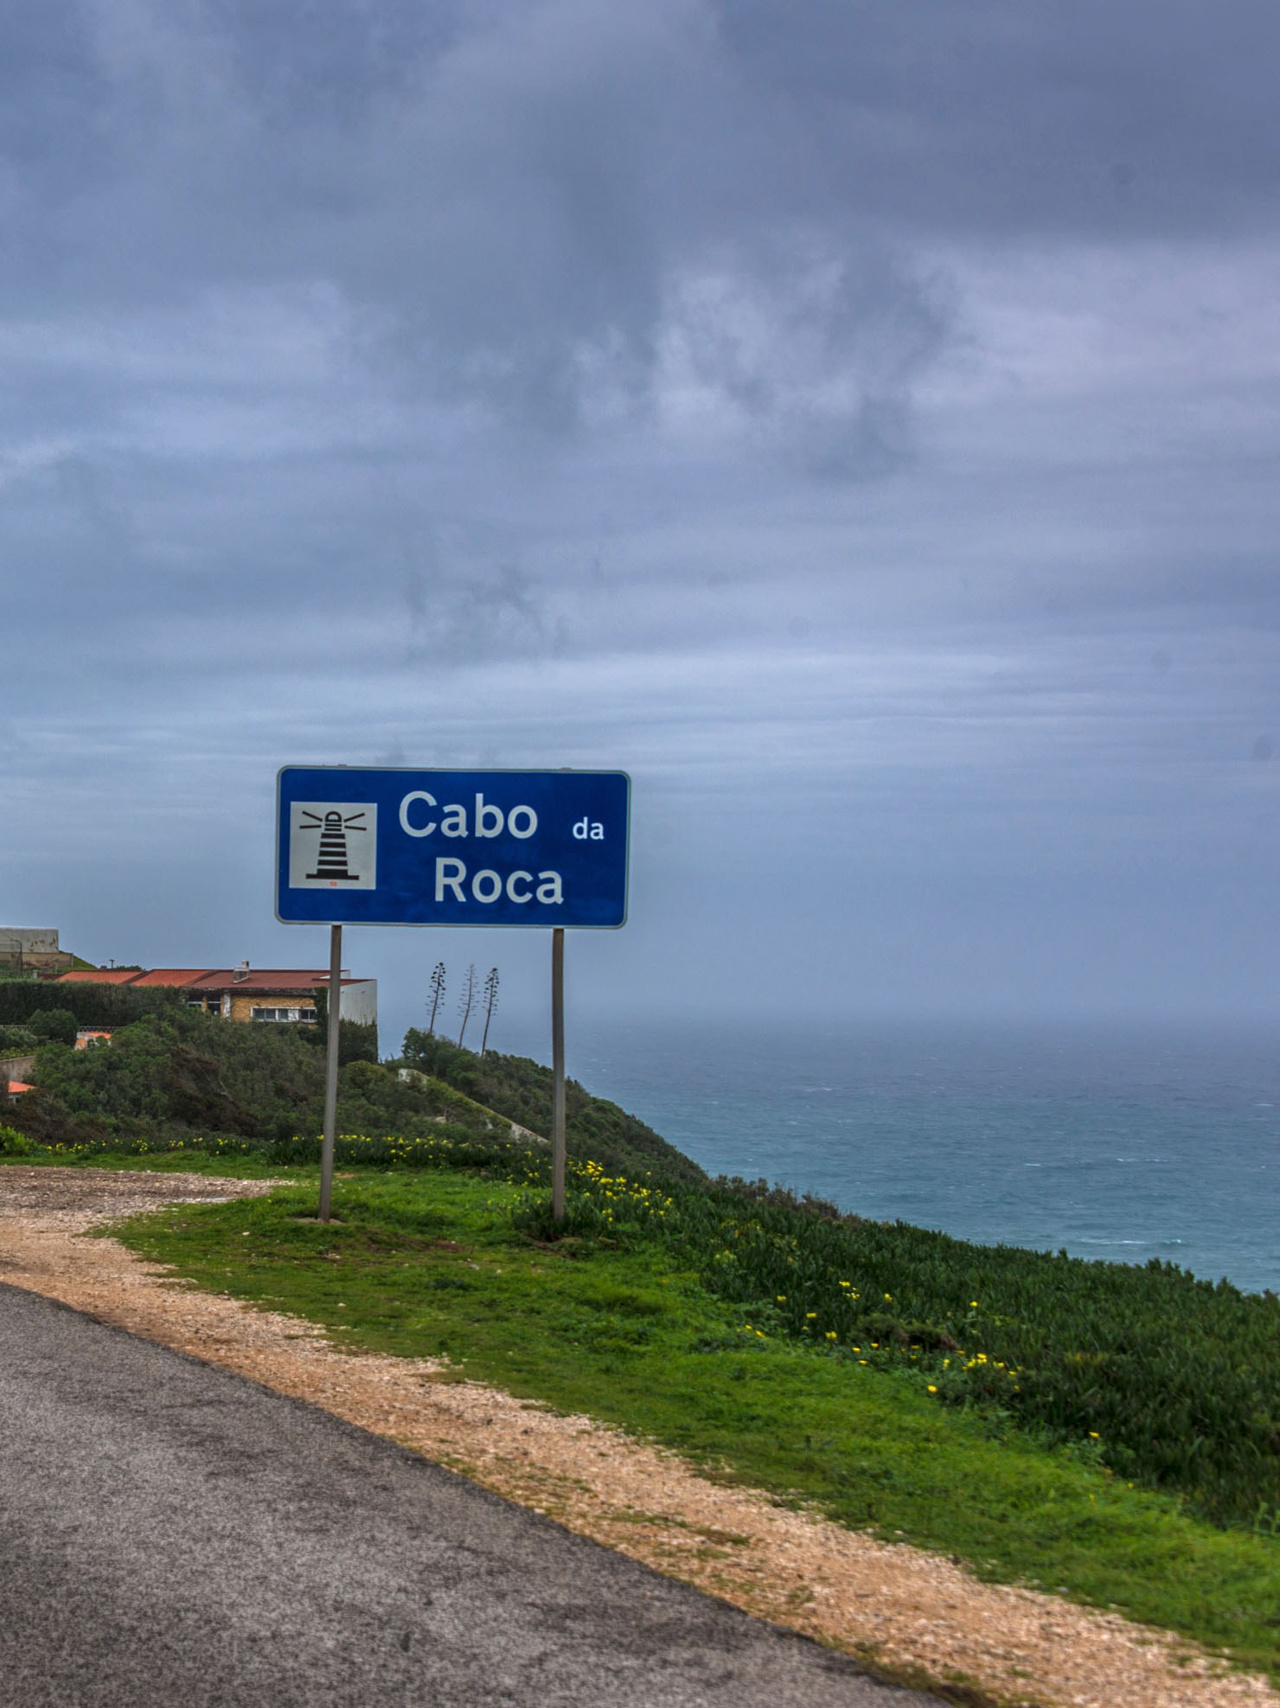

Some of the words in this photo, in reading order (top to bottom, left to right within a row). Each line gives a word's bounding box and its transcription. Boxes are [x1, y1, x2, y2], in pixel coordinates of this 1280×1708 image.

[399, 790, 538, 839] Cabo
[572, 817, 605, 840] da
[435, 857, 564, 904] Roca
